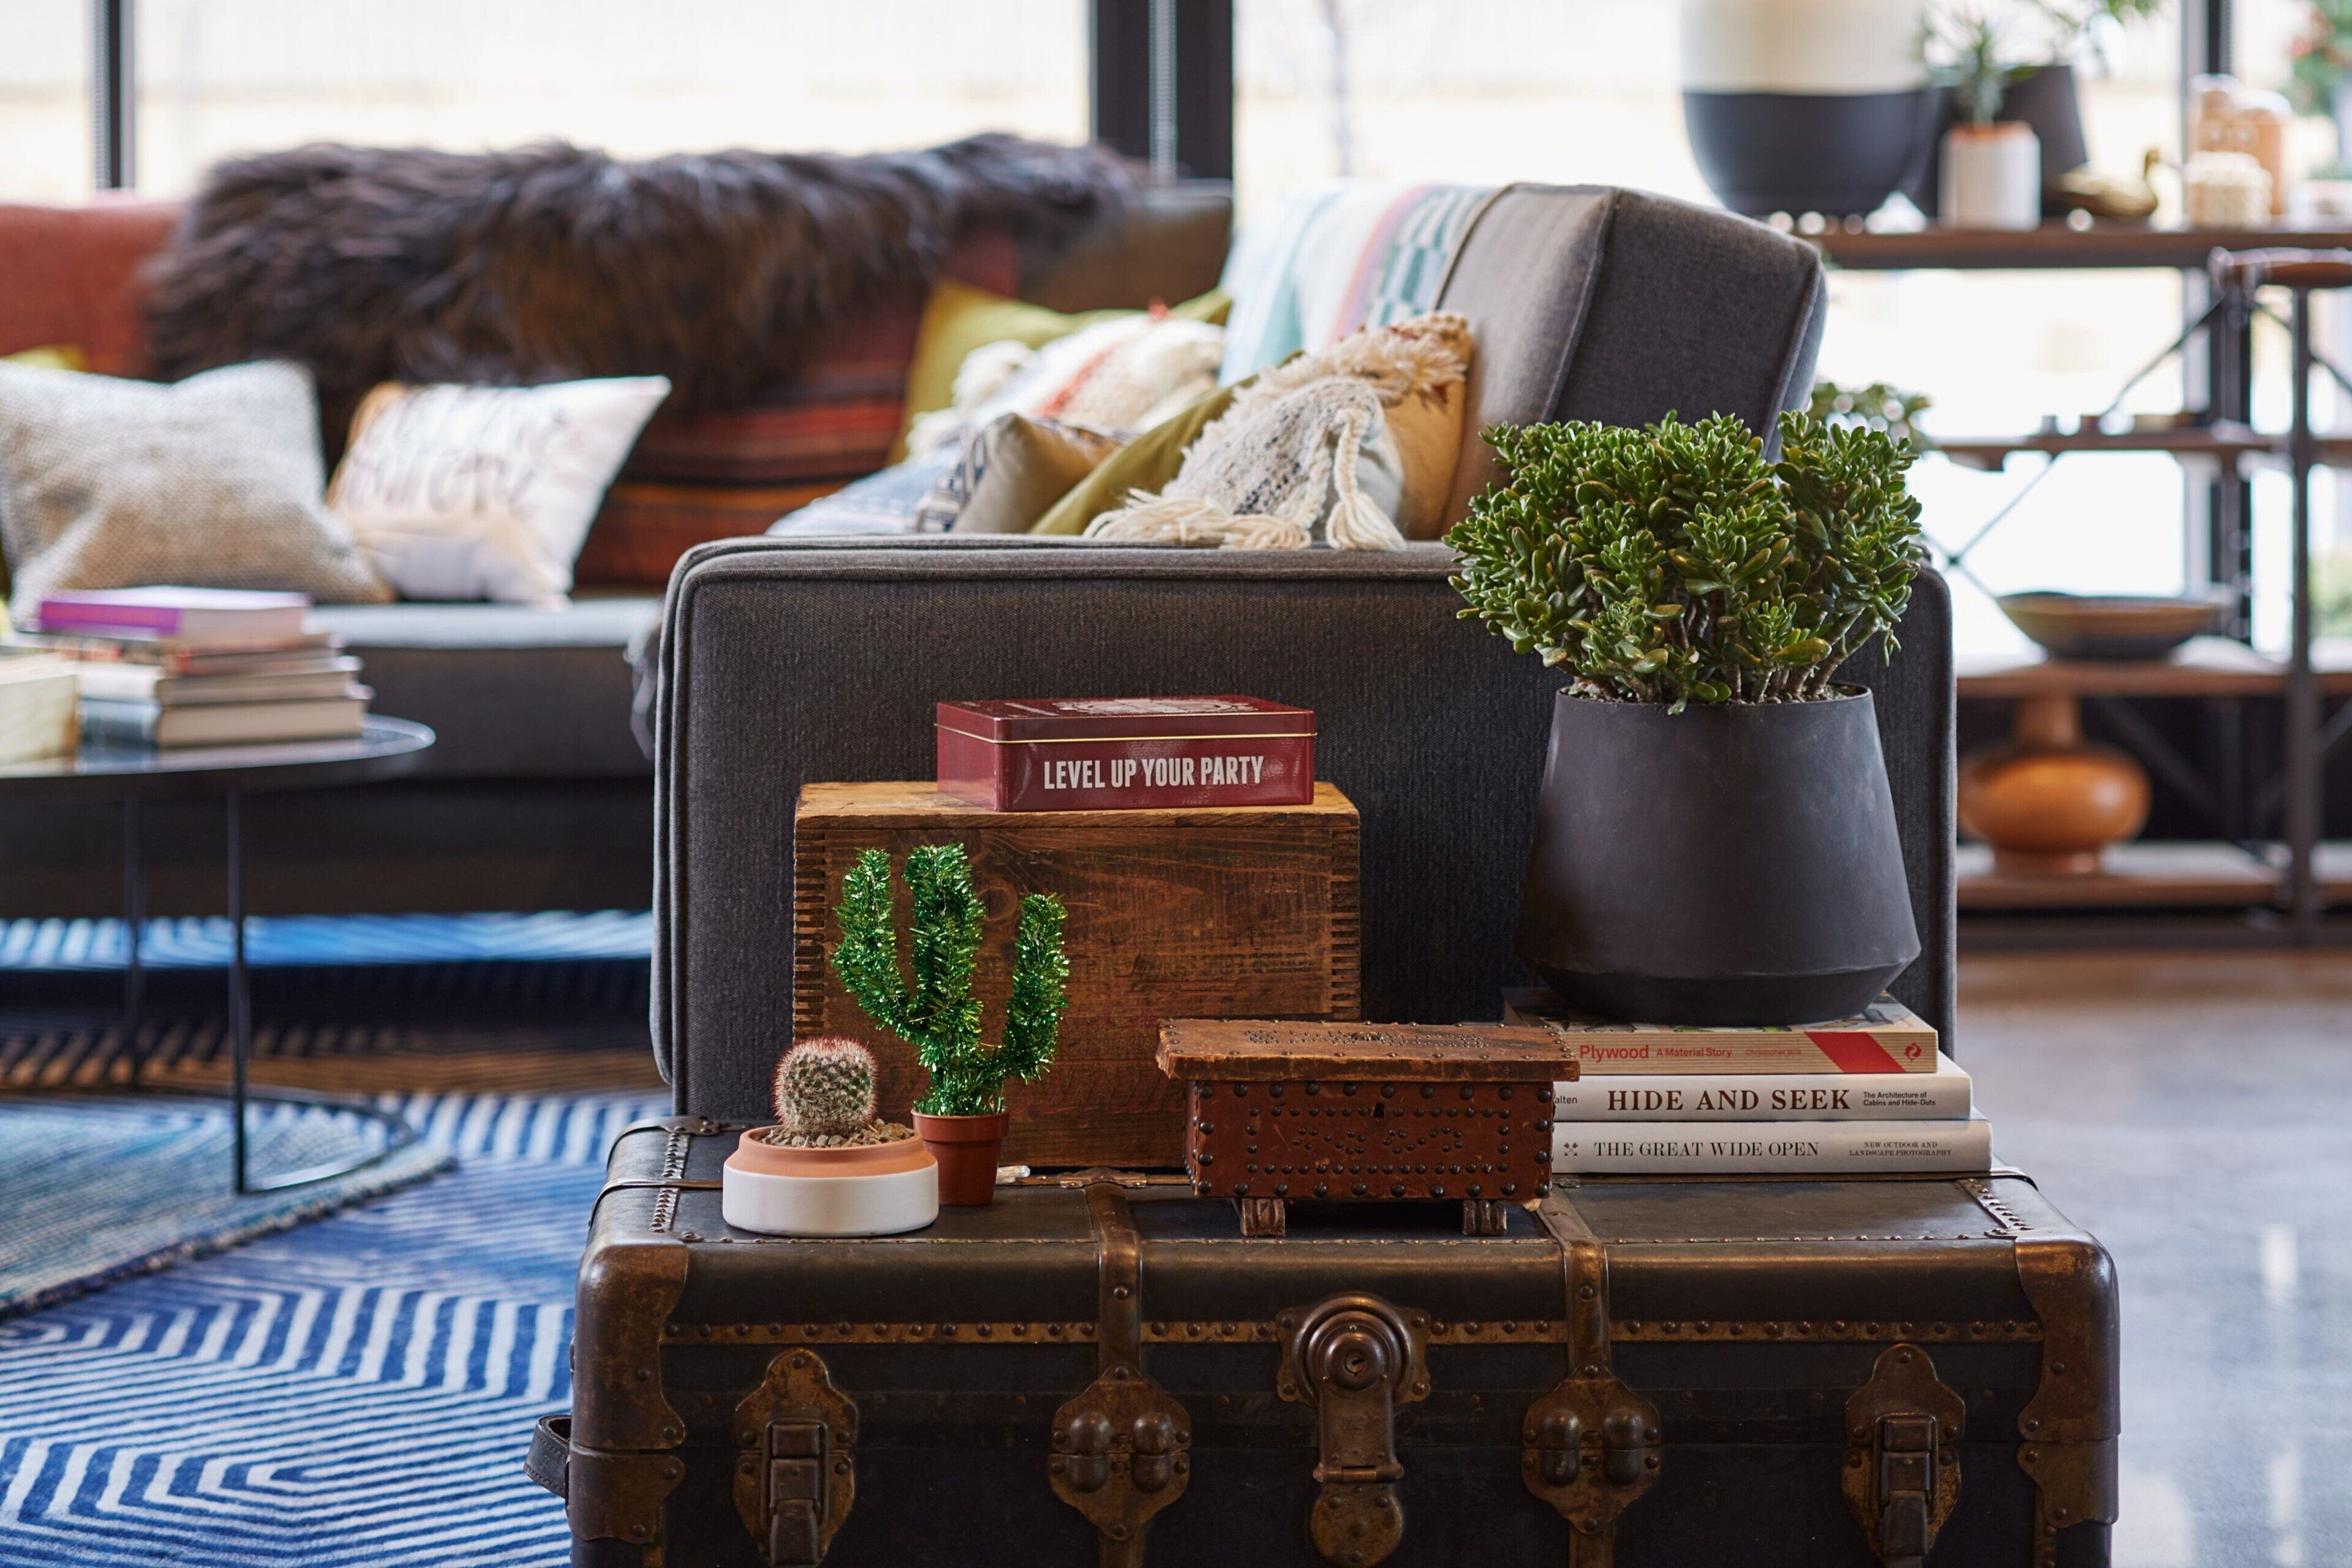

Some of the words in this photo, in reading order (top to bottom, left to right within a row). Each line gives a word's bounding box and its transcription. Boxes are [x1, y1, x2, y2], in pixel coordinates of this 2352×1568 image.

[1044, 760, 1105, 790] LEVEL
[1110, 759, 1137, 788] UP
[1141, 758, 1194, 787] YOUR
[1200, 756, 1264, 785] PARTY
[1579, 1045, 1649, 1063] Plywood
[1656, 1048, 1664, 1057] A
[1665, 1047, 1705, 1057] Material
[1705, 1047, 1733, 1058] Story
[1555, 1095, 1578, 1104] alten
[1607, 1090, 1684, 1110] HIDE
[1695, 1090, 1759, 1110] AND
[1771, 1089, 1851, 1110] SEEK
[1594, 1142, 1634, 1156] THE
[1639, 1142, 1703, 1156] GREAT
[1709, 1142, 1763, 1156] WIDE
[1768, 1142, 1820, 1156] OPEN
